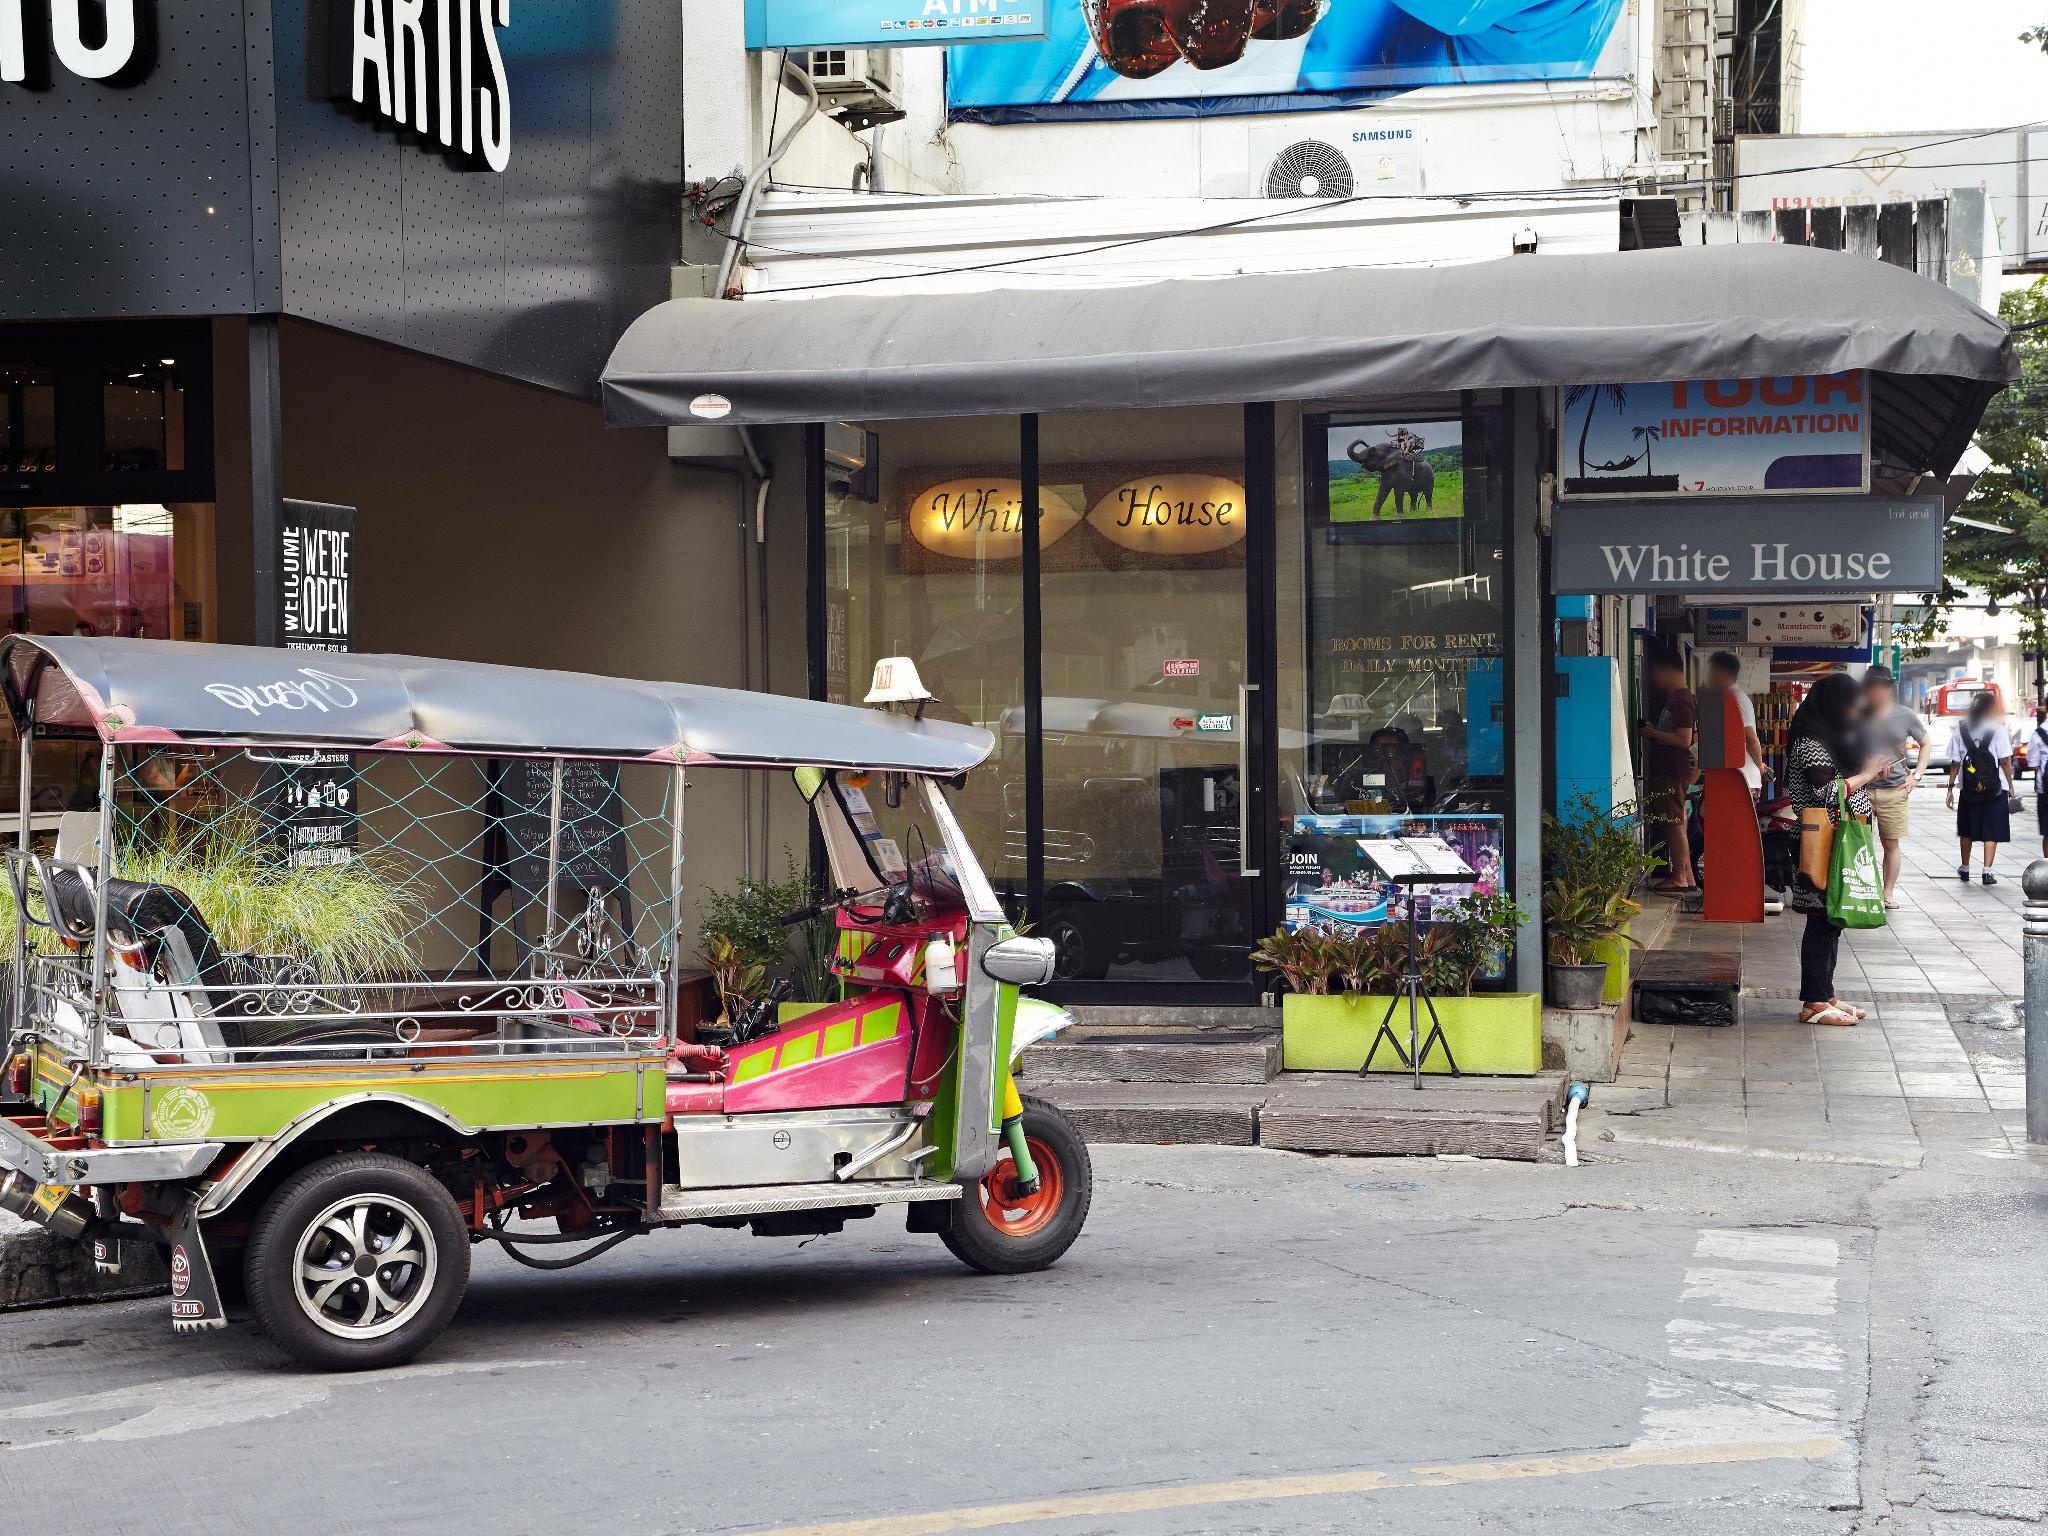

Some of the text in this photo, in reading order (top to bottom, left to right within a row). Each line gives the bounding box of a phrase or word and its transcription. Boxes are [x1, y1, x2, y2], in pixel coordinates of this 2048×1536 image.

[1352, 129, 1413, 142] SAMSUNG
[1660, 412, 1859, 439] INFORMATION
[1116, 484, 1233, 527] House
[303, 527, 350, 579] WE'RE
[1600, 543, 1891, 583] White House
[303, 576, 348, 635] OPEN
[1331, 632, 1496, 652] ROOMS FOR RENT
[1341, 656, 1496, 673] DAILY MONTHLY
[1289, 853, 1318, 865] JOIN
